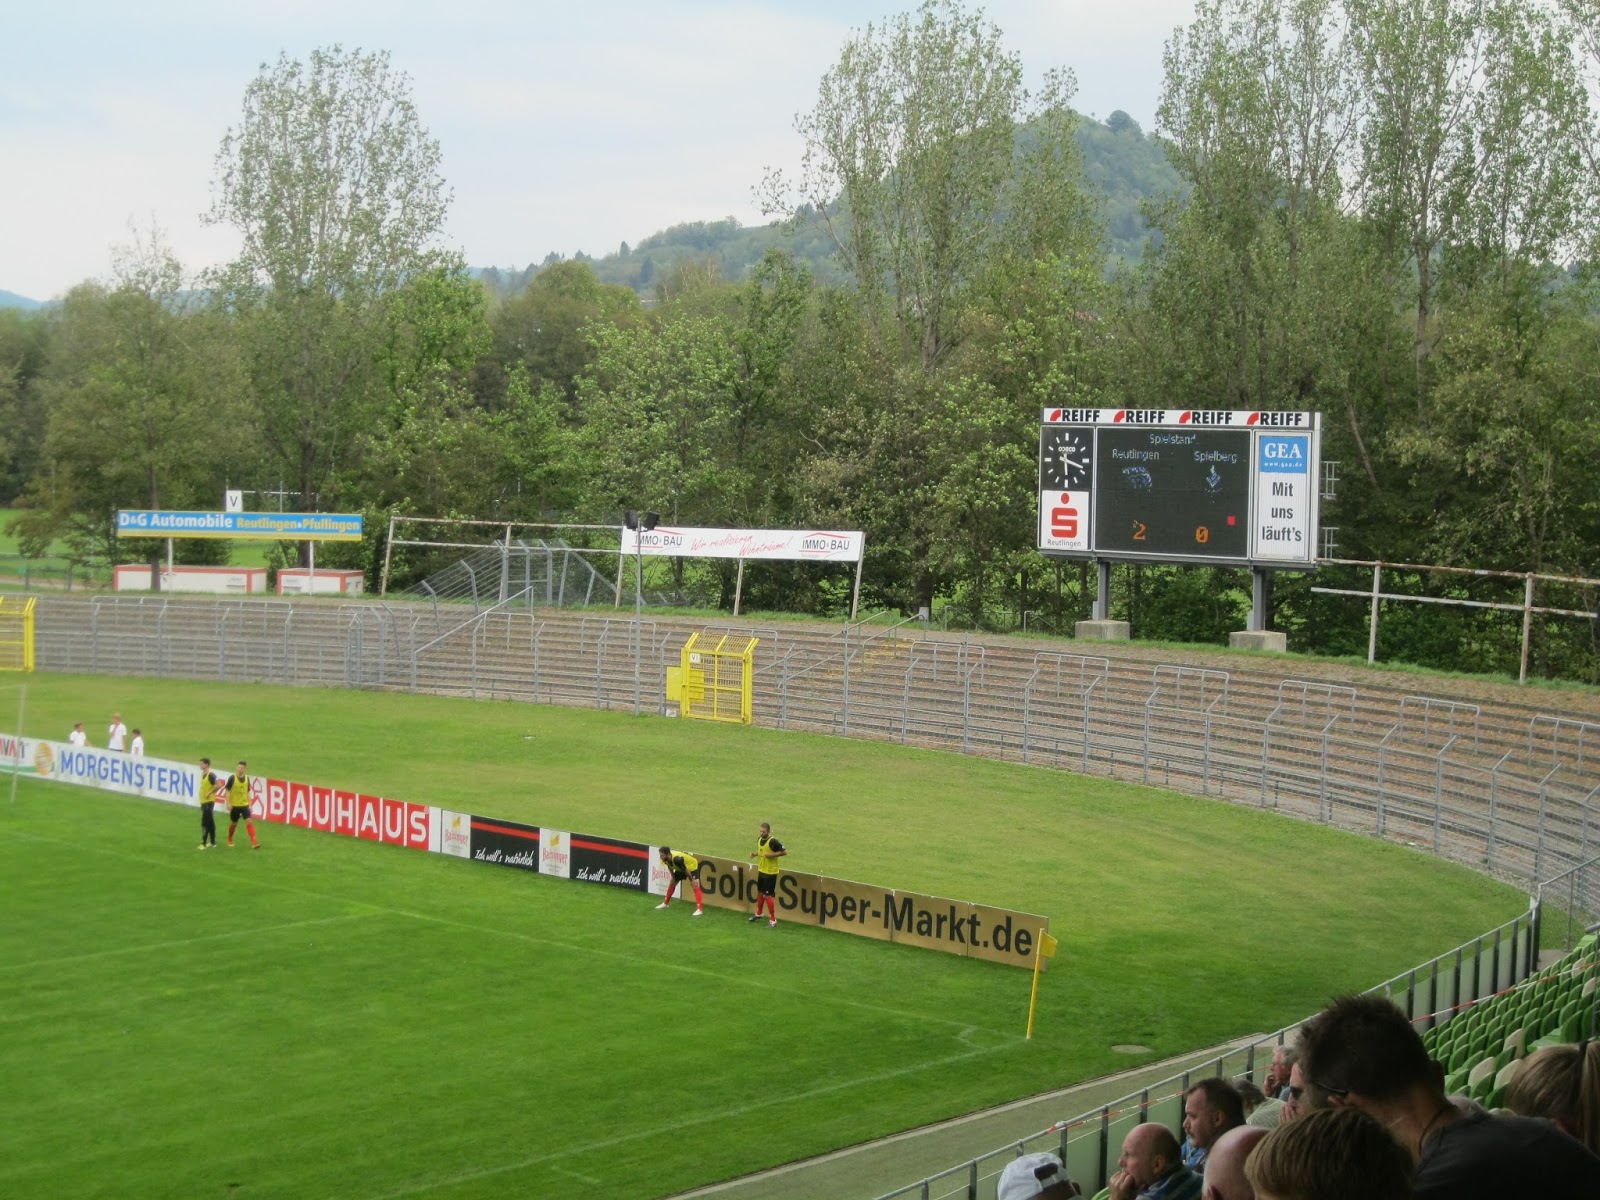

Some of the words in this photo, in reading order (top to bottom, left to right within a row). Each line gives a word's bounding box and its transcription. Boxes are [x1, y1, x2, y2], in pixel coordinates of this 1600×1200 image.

[1061, 409, 1101, 423] REIFF
[1125, 411, 1165, 424] REIFF
[1191, 412, 1232, 425] REIFF
[1259, 413, 1302, 426] REIFF
[1112, 448, 1160, 461] Reutlingen
[1194, 450, 1238, 464] Spielberg
[1264, 442, 1302, 459] GEA
[1272, 482, 1294, 497] Mit
[230, 495, 238, 508] V
[119, 512, 147, 526] D&G
[150, 513, 233, 528] Automobile
[1271, 507, 1294, 520] uns
[1133, 520, 1147, 540] 2
[1195, 526, 1209, 543] 0
[1261, 525, 1302, 542] läuft's
[690, 537, 707, 551] Wir
[1046, 538, 1081, 549] Reutlingen
[60, 749, 195, 798] MORGENSTERN
[269, 784, 428, 844] BAUHAUS
[474, 847, 487, 860] Ich
[504, 849, 534, 866] natürlich
[576, 866, 589, 880] Ich
[609, 868, 641, 886] natürlich
[778, 874, 1033, 956] Super-Markt.de
